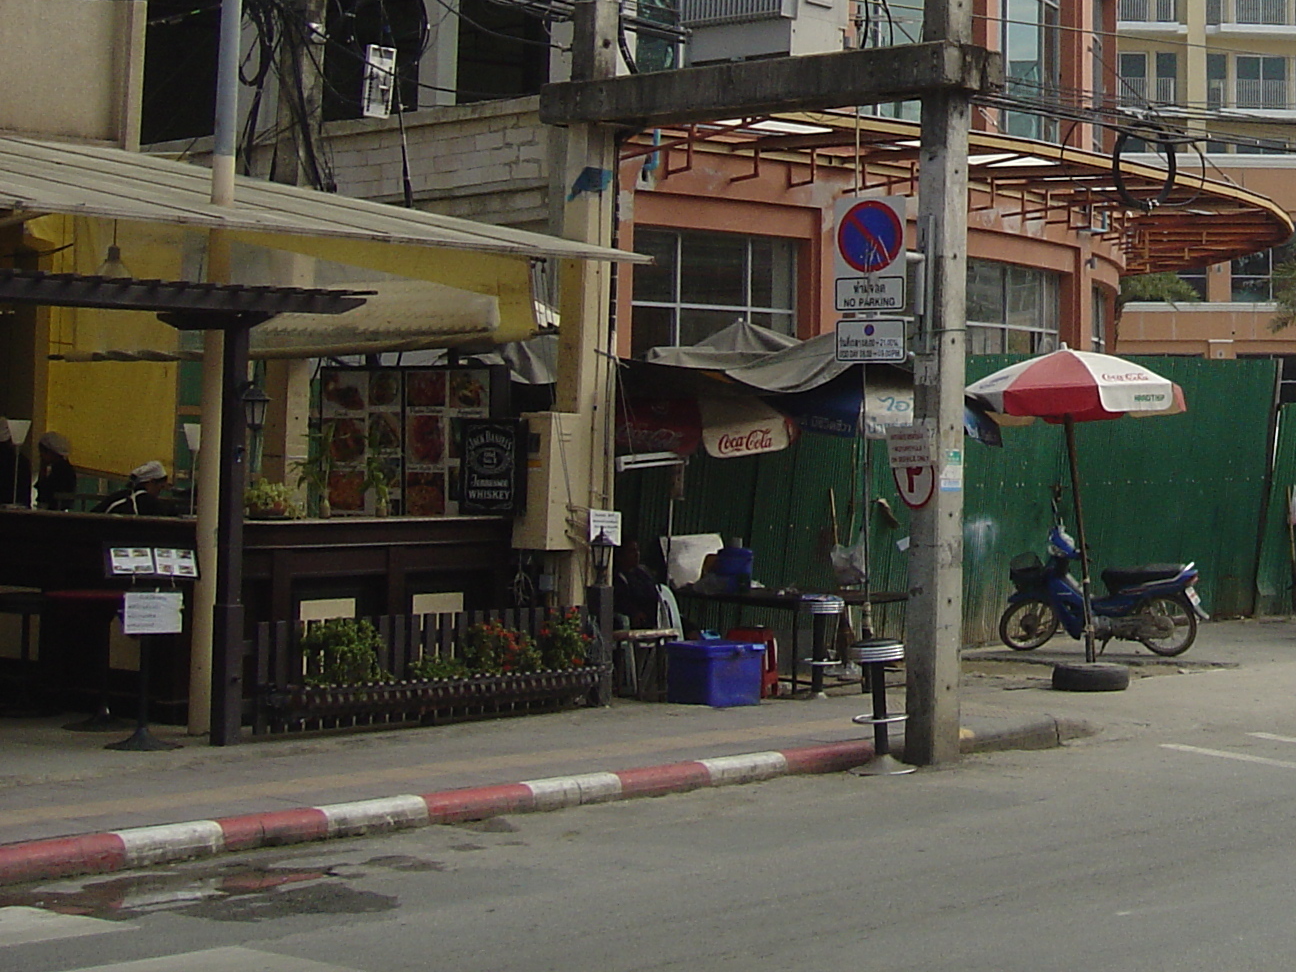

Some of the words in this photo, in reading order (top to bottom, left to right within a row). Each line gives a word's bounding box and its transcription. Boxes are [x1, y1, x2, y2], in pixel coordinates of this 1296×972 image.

[843, 298, 856, 307] NO
[858, 297, 896, 307] PARKING
[717, 429, 773, 455] Coca-Cola
[468, 489, 511, 500] WHISKEY
